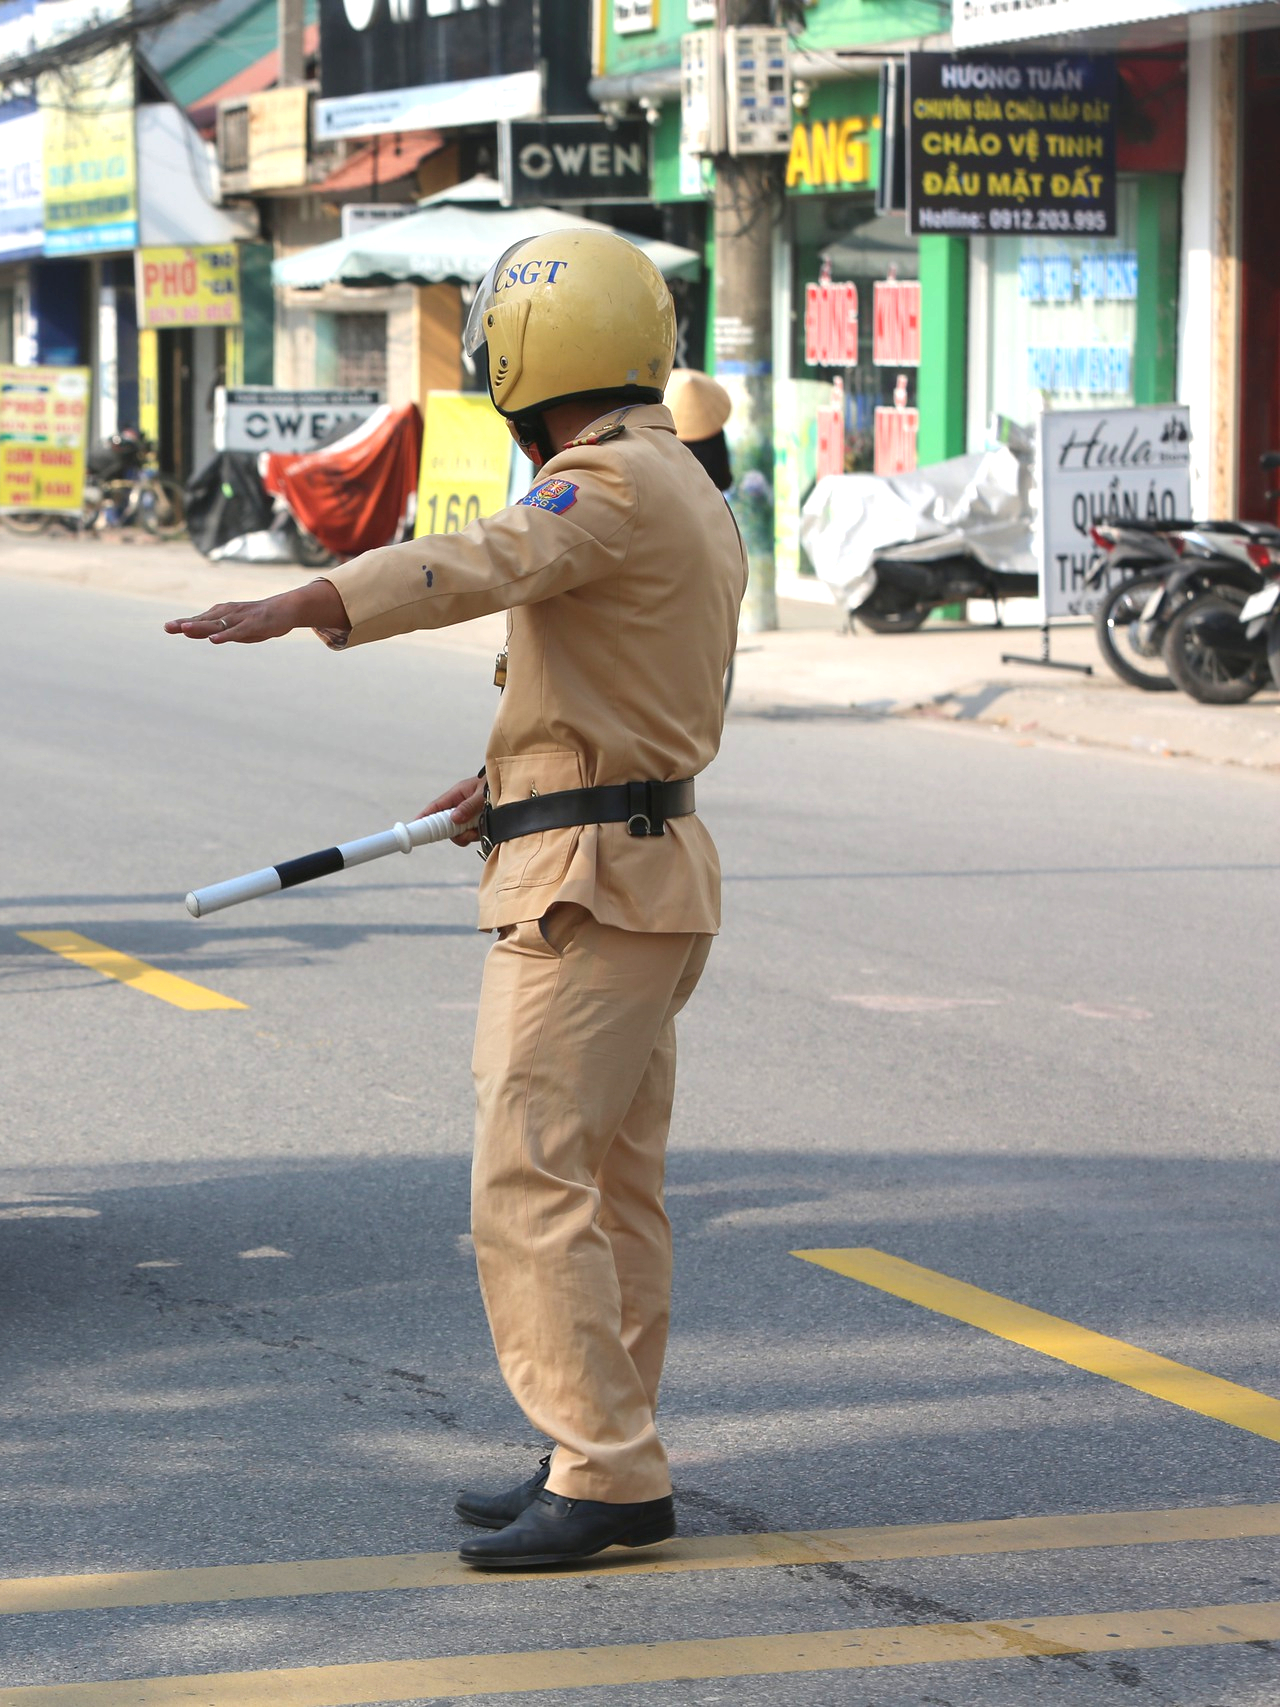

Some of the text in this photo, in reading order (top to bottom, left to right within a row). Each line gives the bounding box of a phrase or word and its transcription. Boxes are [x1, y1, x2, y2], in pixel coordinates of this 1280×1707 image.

[940, 59, 1083, 91] HƯƠNG TUẤN
[913, 94, 971, 121] CHUYÊN
[519, 142, 641, 179] OWEN
[921, 125, 1103, 163] CHẢO VỆ TINH
[921, 161, 1104, 204] ĐẦU MẶT ĐẤT
[919, 206, 1107, 232] Hotline: 0912.203.995
[144, 249, 198, 298] PHỞ
[494, 260, 569, 294] CSGT
[245, 410, 360, 440] OWE
[1058, 418, 1154, 470] Hula
[522, 495, 559, 512] CSGT
[1145, 478, 1176, 522] ÁO
